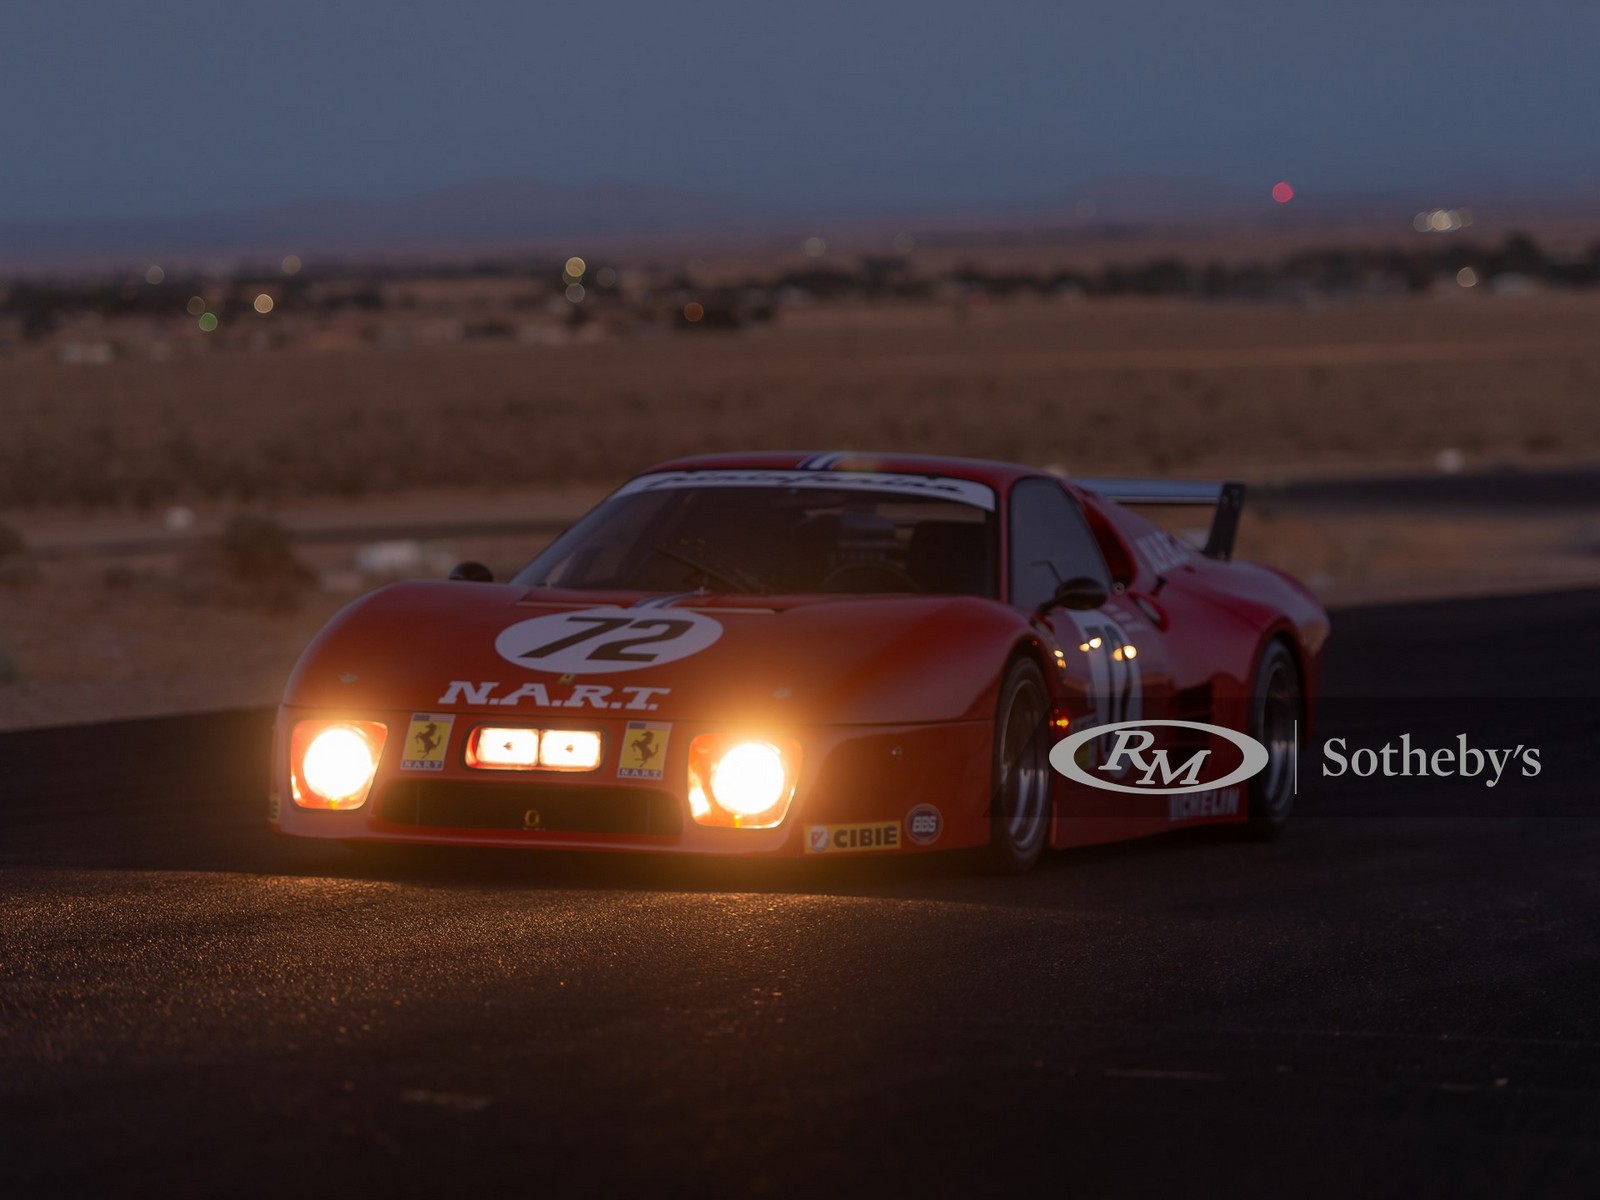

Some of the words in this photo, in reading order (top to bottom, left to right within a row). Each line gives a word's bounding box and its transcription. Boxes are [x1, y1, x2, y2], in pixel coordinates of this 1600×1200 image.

[519, 616, 695, 662] 72
[438, 681, 671, 710] N.A.R.T.
[911, 815, 938, 833] BBS
